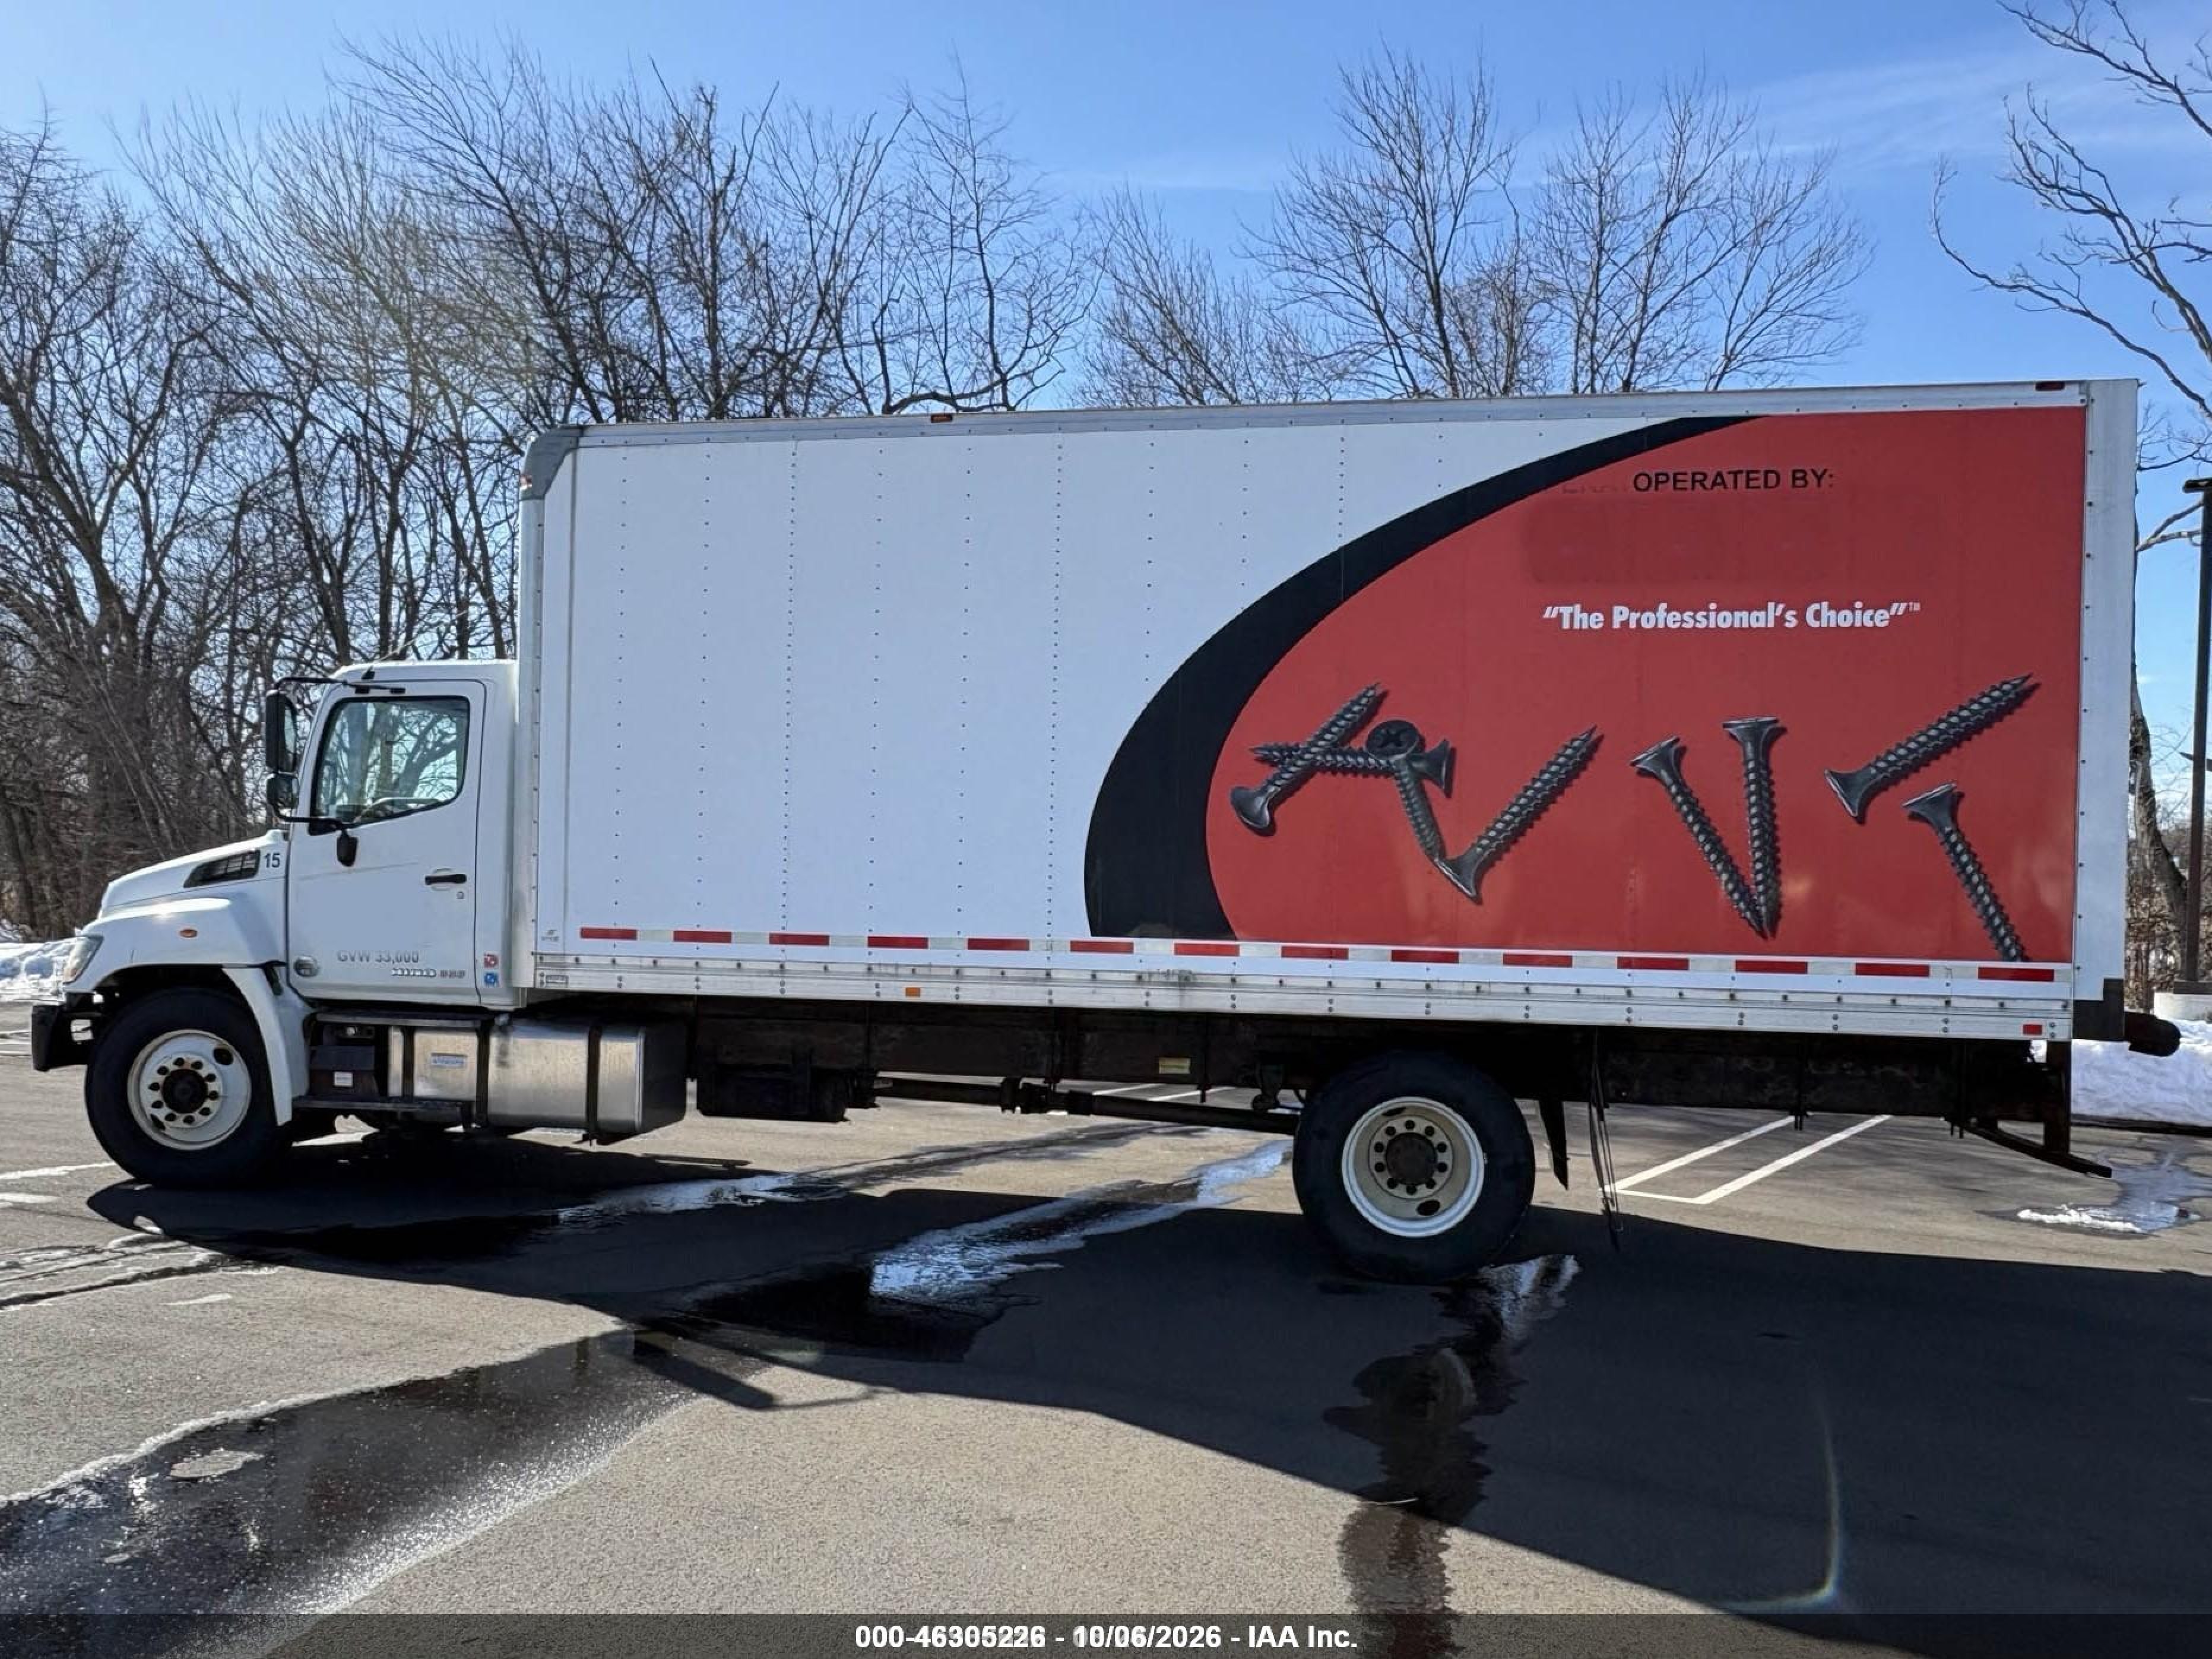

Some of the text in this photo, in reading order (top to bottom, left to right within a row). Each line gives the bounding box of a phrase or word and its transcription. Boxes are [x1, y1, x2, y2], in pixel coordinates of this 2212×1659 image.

[1633, 470, 1780, 492] OPERATED
[1791, 468, 1834, 489] BY:
[1612, 603, 1798, 629] Professional’s
[264, 852, 281, 869] 15
[338, 950, 370, 962] GVW
